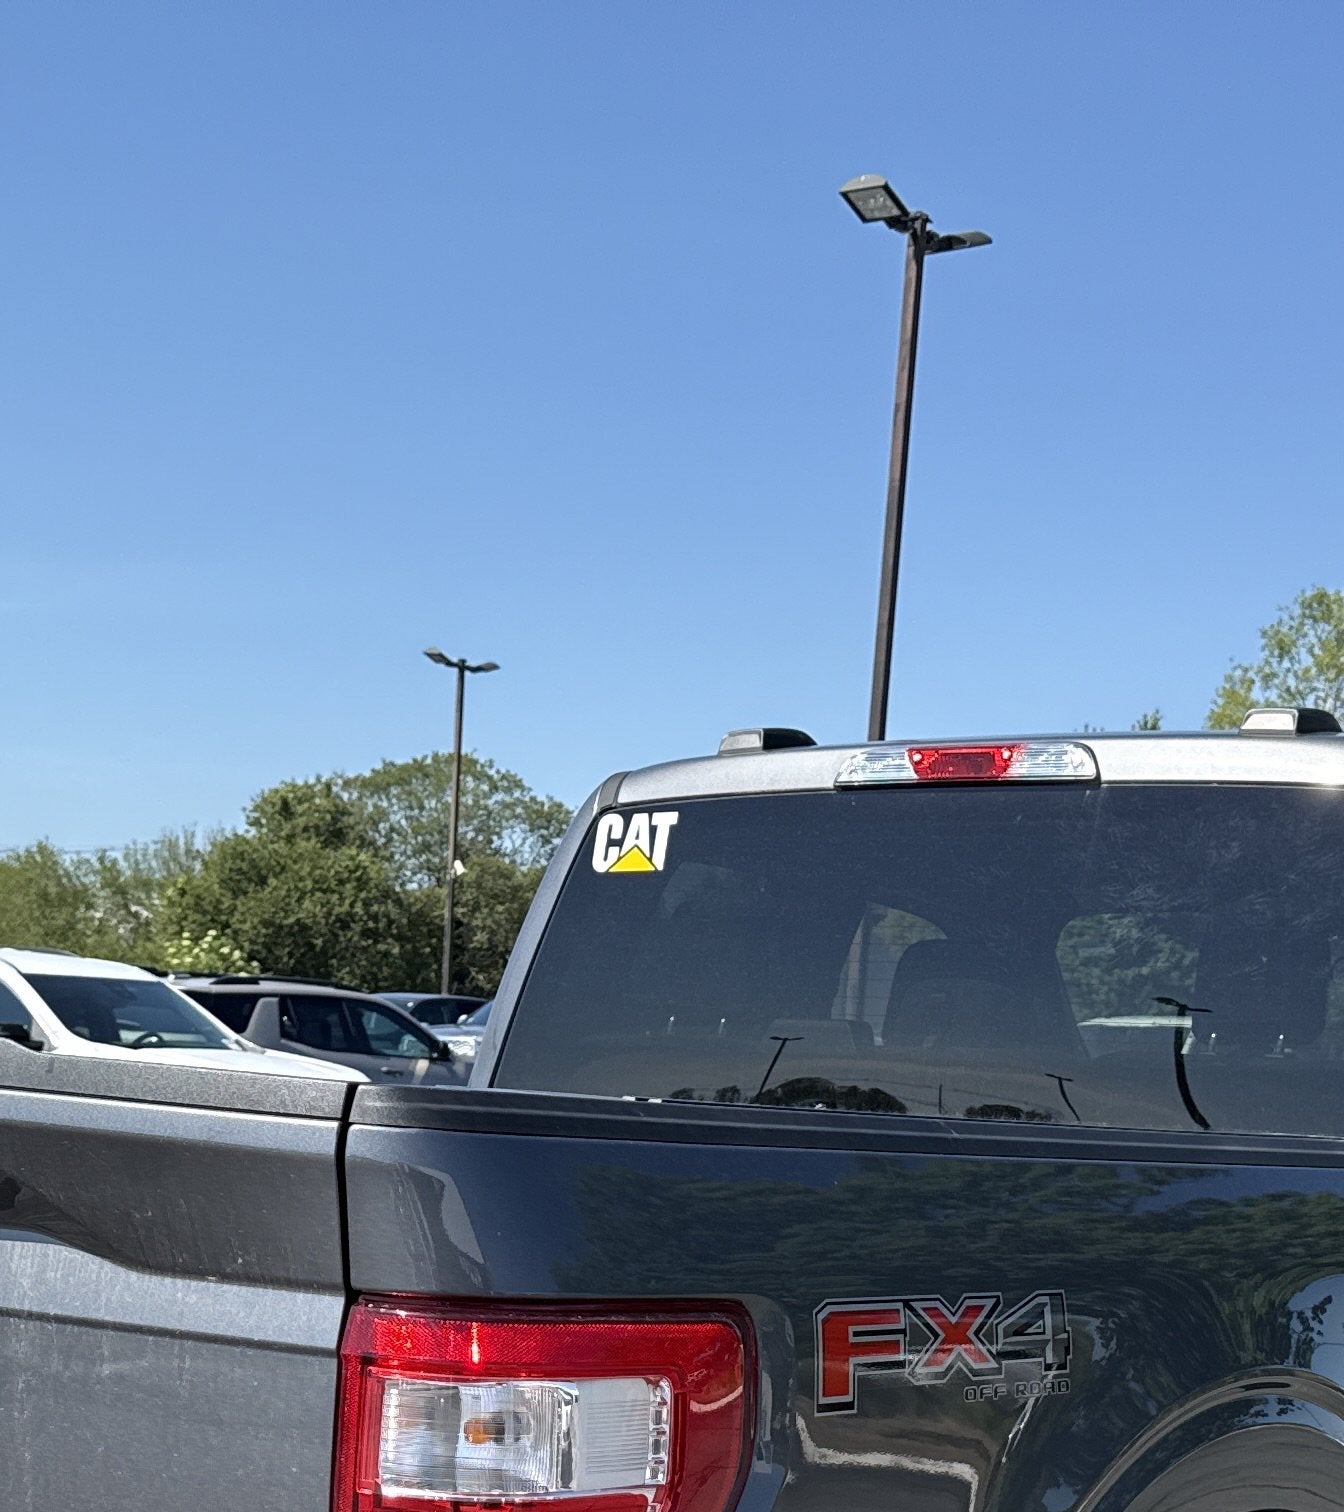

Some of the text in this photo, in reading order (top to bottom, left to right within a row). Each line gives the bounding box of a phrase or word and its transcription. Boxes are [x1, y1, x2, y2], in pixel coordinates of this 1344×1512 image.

[592, 811, 679, 873] CAT
[813, 1290, 1072, 1416] FX4
[964, 1378, 1071, 1402] OFF ROAD
